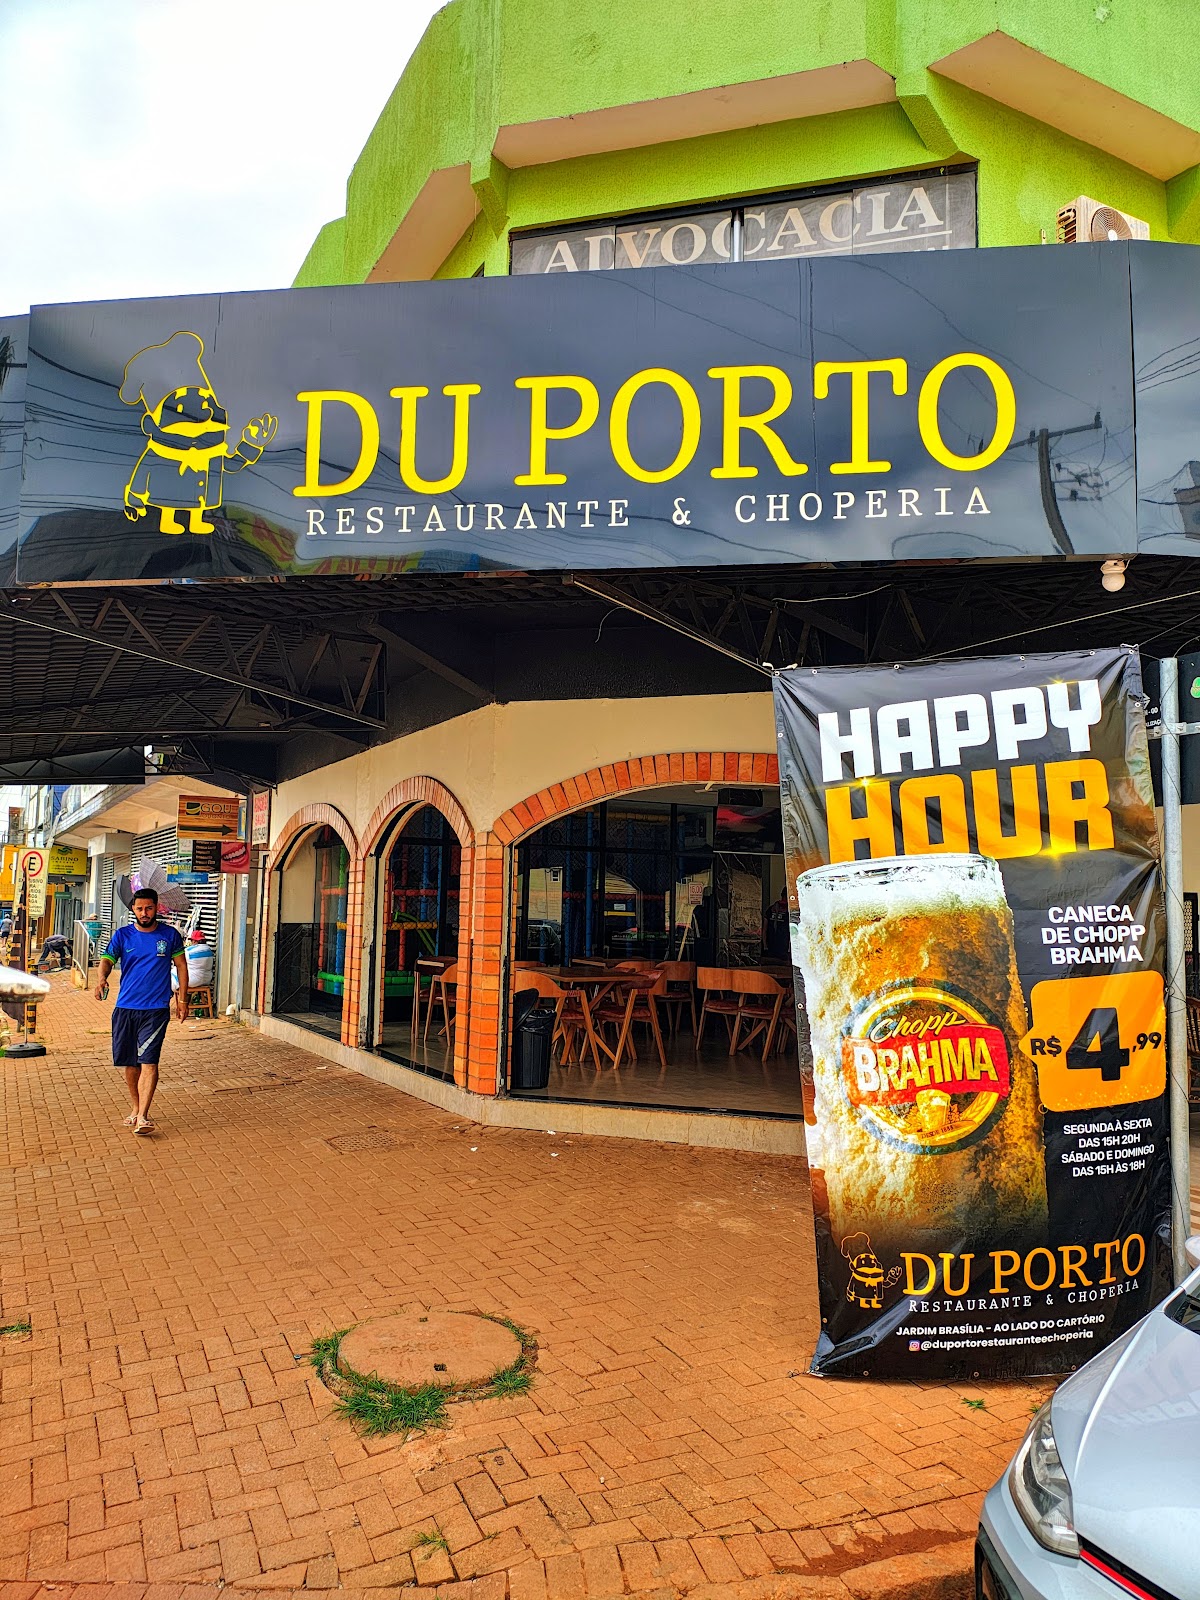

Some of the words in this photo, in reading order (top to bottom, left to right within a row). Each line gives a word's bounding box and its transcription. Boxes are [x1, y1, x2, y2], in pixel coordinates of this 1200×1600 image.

[292, 383, 482, 497] DU
[513, 352, 1017, 486] PORTO
[306, 499, 629, 536] RESTAURANTE
[672, 497, 692, 527] &
[734, 486, 991, 524] CHOPERIA
[818, 679, 1102, 782] HAPPY
[824, 759, 1115, 864] HOUR
[28, 856, 37, 871] E
[1048, 904, 1134, 924] CANECA
[1041, 927, 1072, 945] DE
[1073, 924, 1146, 944] CHOPP
[1050, 945, 1144, 965] BRAHMA
[869, 1011, 967, 1044] Chopp
[1030, 1035, 1062, 1057] R$
[853, 1037, 999, 1093] BRAHMA
[1063, 1121, 1114, 1135] SEGUNDA
[1123, 1117, 1153, 1131] SEXTA
[1078, 1136, 1100, 1149] DAS
[1101, 1134, 1120, 1147] 15H
[1121, 1133, 1141, 1146] 20H
[1061, 1150, 1105, 1164] SÁBADO
[1106, 1150, 1113, 1161] E
[1114, 1144, 1155, 1160] DOMINGO
[1072, 1165, 1094, 1177] DAS
[1095, 1163, 1114, 1176] 15H
[1114, 1160, 1129, 1174] ÀS
[1130, 1159, 1146, 1171] 18H
[900, 1252, 975, 1297] DU
[988, 1233, 1146, 1294] PORTO
[908, 1295, 1032, 1313] RESTAURANTE
[1046, 1294, 1054, 1306] &
[1067, 1279, 1140, 1304] CHOPERIA
[896, 1326, 937, 1336] JARDIM
[939, 1322, 984, 1335] BRASÍLIA
[993, 1322, 1010, 1333] AO
[1011, 1320, 1038, 1332] LADO
[1040, 1319, 1055, 1330] DO
[1056, 1313, 1105, 1328] CARTÓRIO
[920, 1328, 1094, 1352] @duportorestauranteechoperia
